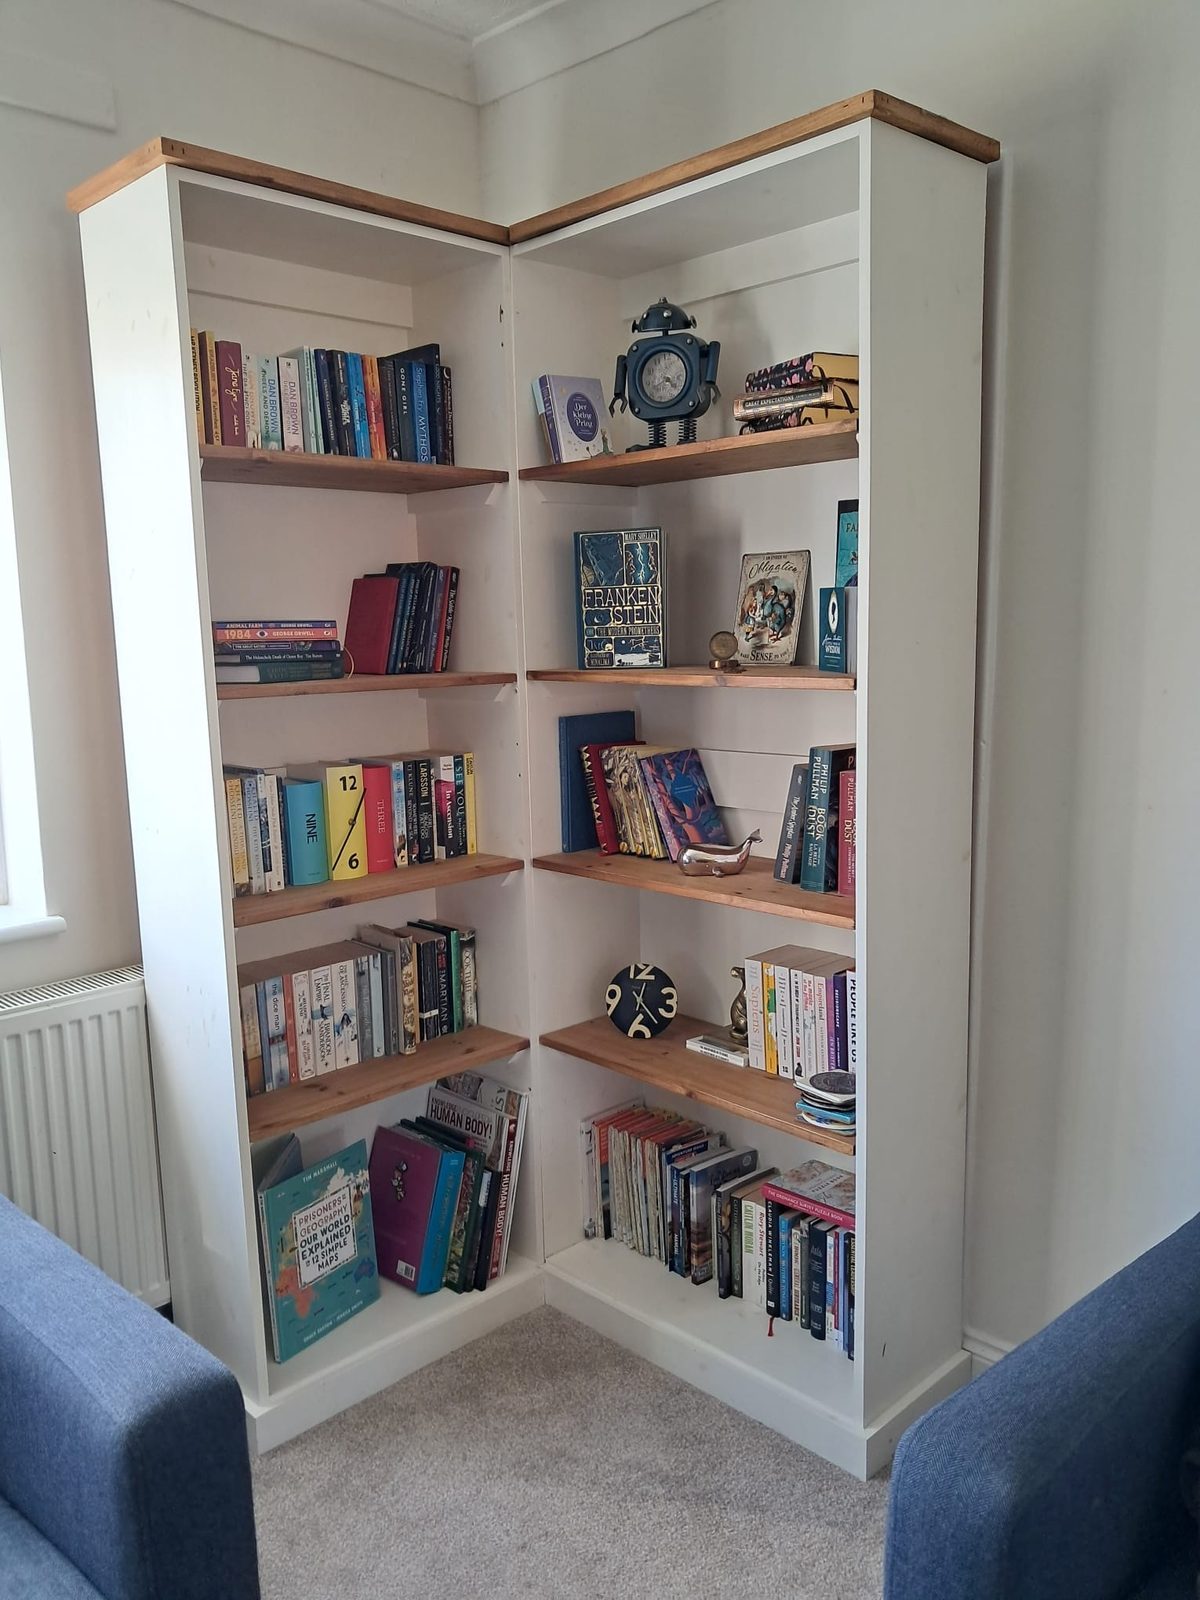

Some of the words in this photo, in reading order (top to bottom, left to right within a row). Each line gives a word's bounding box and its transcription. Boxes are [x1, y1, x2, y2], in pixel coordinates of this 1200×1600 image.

[225, 367, 241, 387] Jane
[415, 367, 423, 398] Stephen
[225, 388, 241, 402] Eyre
[269, 400, 278, 433] BROWN
[290, 402, 299, 435] BROWN
[418, 416, 428, 461] MYTHOS
[749, 559, 799, 579] Obligation
[584, 587, 658, 607] FRANKEN
[613, 606, 659, 624] STEIN
[224, 629, 251, 640] 1984
[750, 650, 773, 661] SENSE
[339, 775, 358, 791] 12
[420, 763, 428, 797] LARSSON
[811, 756, 821, 799] PULLMAN
[446, 790, 451, 798] In
[305, 813, 318, 845] NINE
[377, 799, 386, 833] THREE
[446, 799, 454, 839] Ascension
[807, 809, 816, 838] DUST
[815, 808, 826, 841] BOOK
[844, 820, 852, 844] DUST
[348, 852, 360, 870] 6
[782, 843, 792, 857] Philip
[780, 857, 789, 878] Pullman
[629, 963, 655, 980] 12
[314, 977, 322, 1003] EMPIRE
[439, 974, 447, 1022] MARTIAN
[605, 984, 622, 1017] 9
[658, 986, 678, 1019] 3
[751, 985, 760, 1034] Sapiens
[628, 1013, 651, 1038] 6
[852, 1049, 856, 1063] US
[431, 1104, 463, 1128] HUMAN
[465, 1117, 493, 1139] BODY!
[505, 1140, 514, 1172] KNOWLEDGE
[499, 1174, 510, 1208] HUMAN
[299, 1197, 341, 1225] PRISONERS
[300, 1204, 348, 1238] GEOGRAPHY
[495, 1211, 505, 1237] BODY!
[744, 1205, 753, 1229] CAITLIN
[831, 1213, 843, 1221] BOOK
[300, 1233, 318, 1249] OUR
[321, 1214, 350, 1236] WORLD
[301, 1224, 351, 1261] EXPLAINED
[745, 1231, 754, 1254] MORAN
[312, 1256, 319, 1265] 12
[321, 1237, 347, 1260] SIMPLE
[317, 1253, 339, 1272] MAPS
